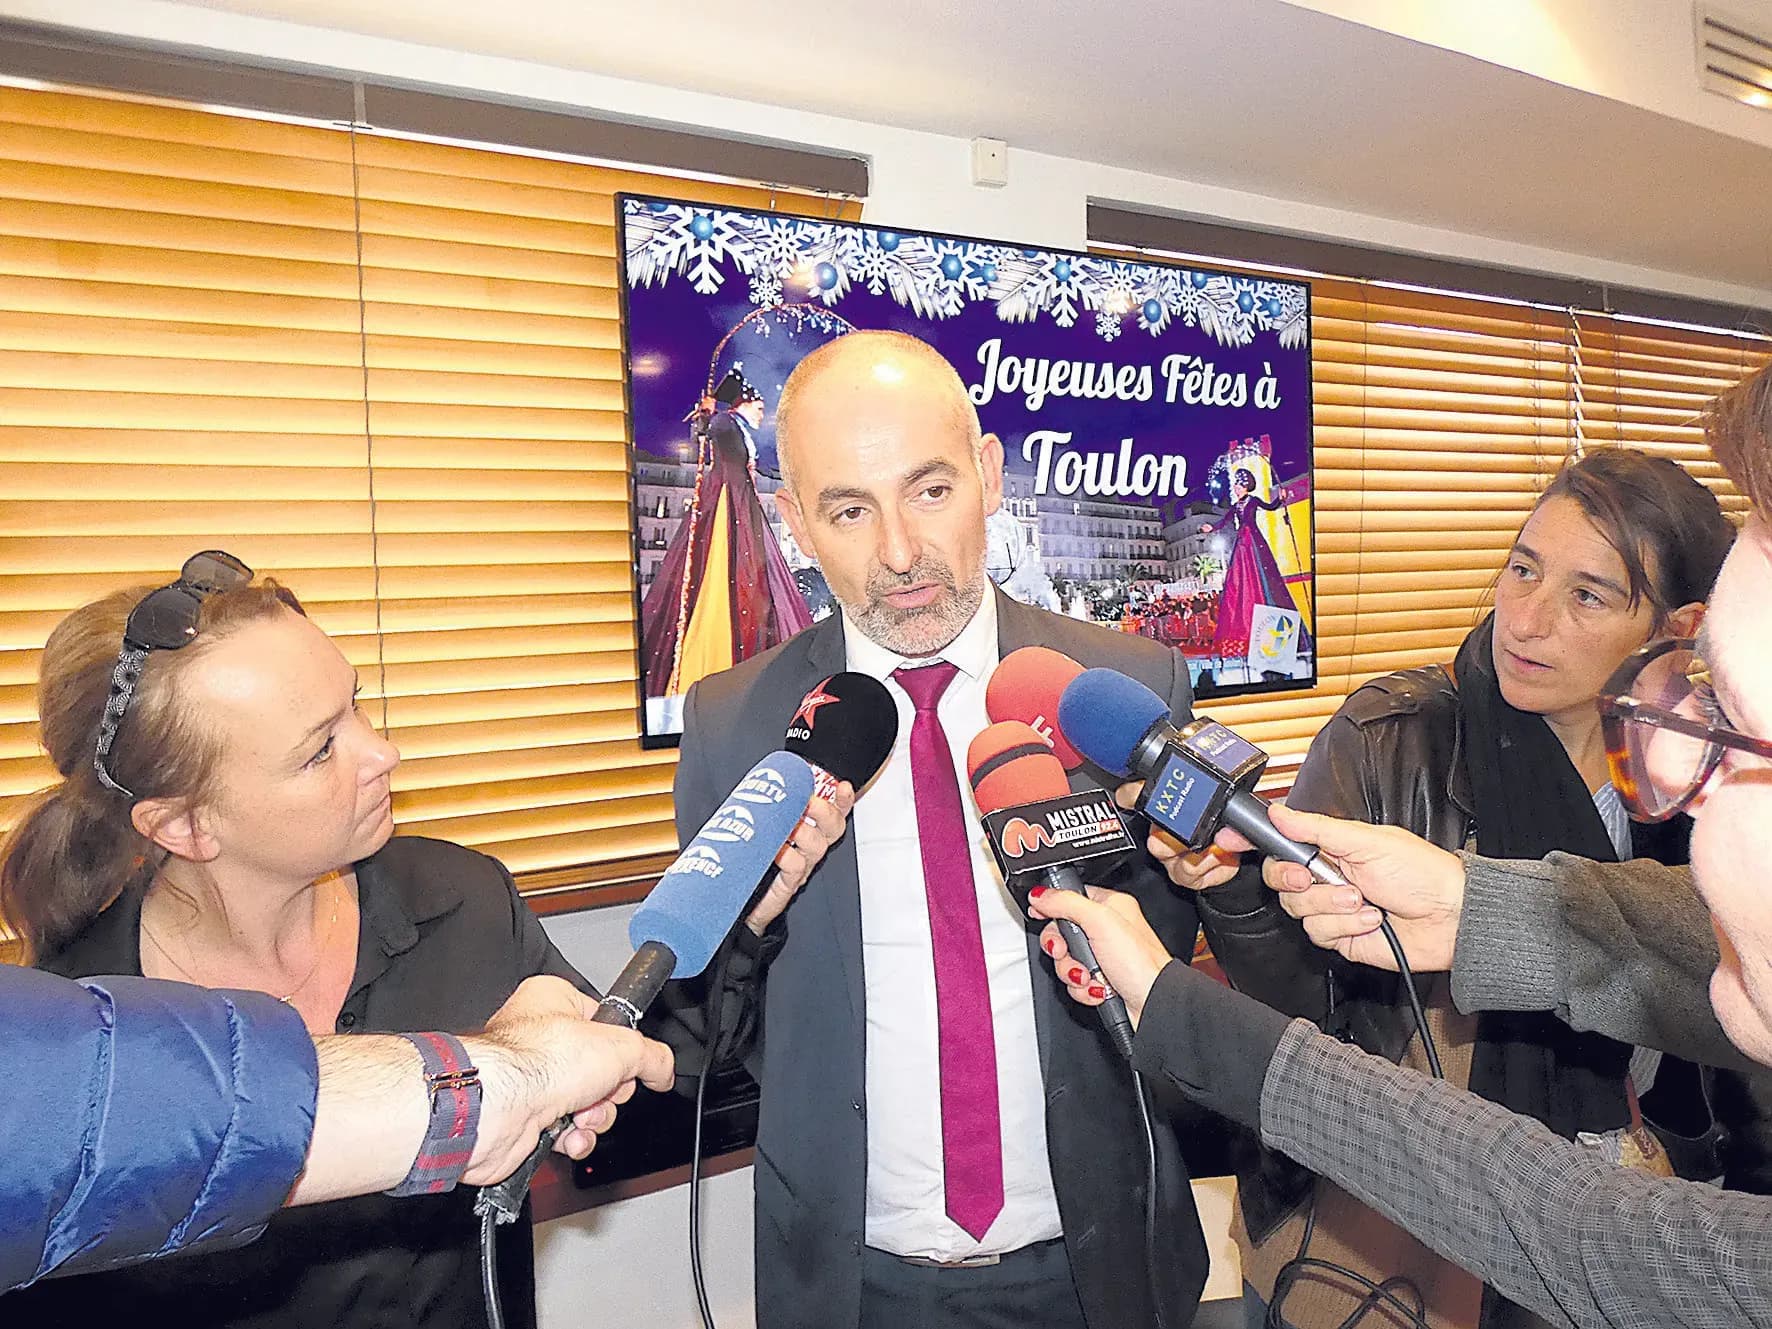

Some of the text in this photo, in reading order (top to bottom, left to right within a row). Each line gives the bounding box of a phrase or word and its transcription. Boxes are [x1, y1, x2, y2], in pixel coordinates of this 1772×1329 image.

[969, 338, 1282, 411] Joyeuses Fêtes à
[1022, 430, 1189, 497] Toulon
[1180, 777, 1195, 797] Radio
[1045, 801, 1117, 831] MISTRAL
[1059, 825, 1098, 840] TOULON
